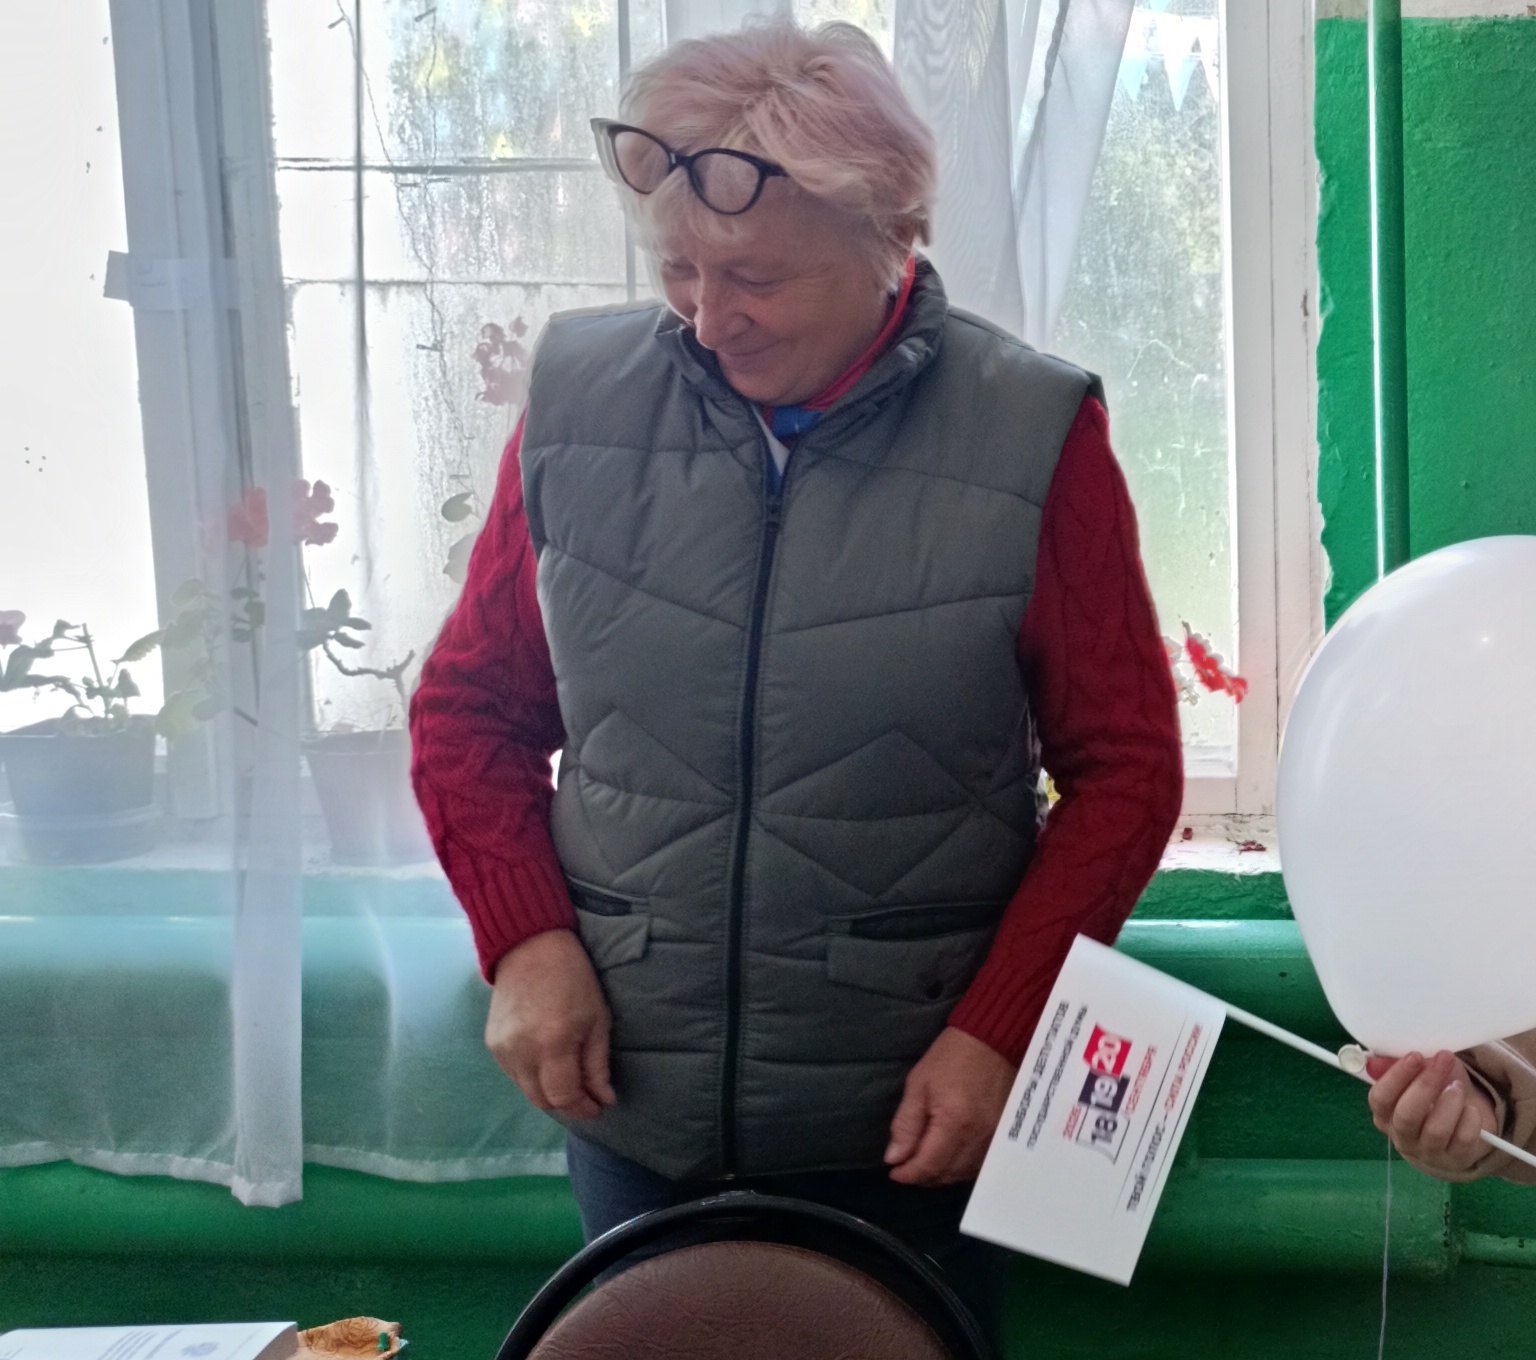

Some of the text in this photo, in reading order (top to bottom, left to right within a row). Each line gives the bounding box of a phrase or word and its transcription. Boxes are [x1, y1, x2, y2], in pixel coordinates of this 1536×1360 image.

[1091, 1033, 1122, 1076] 20
[1091, 1075, 1119, 1108] 19
[1091, 1115, 1118, 1145] 18
